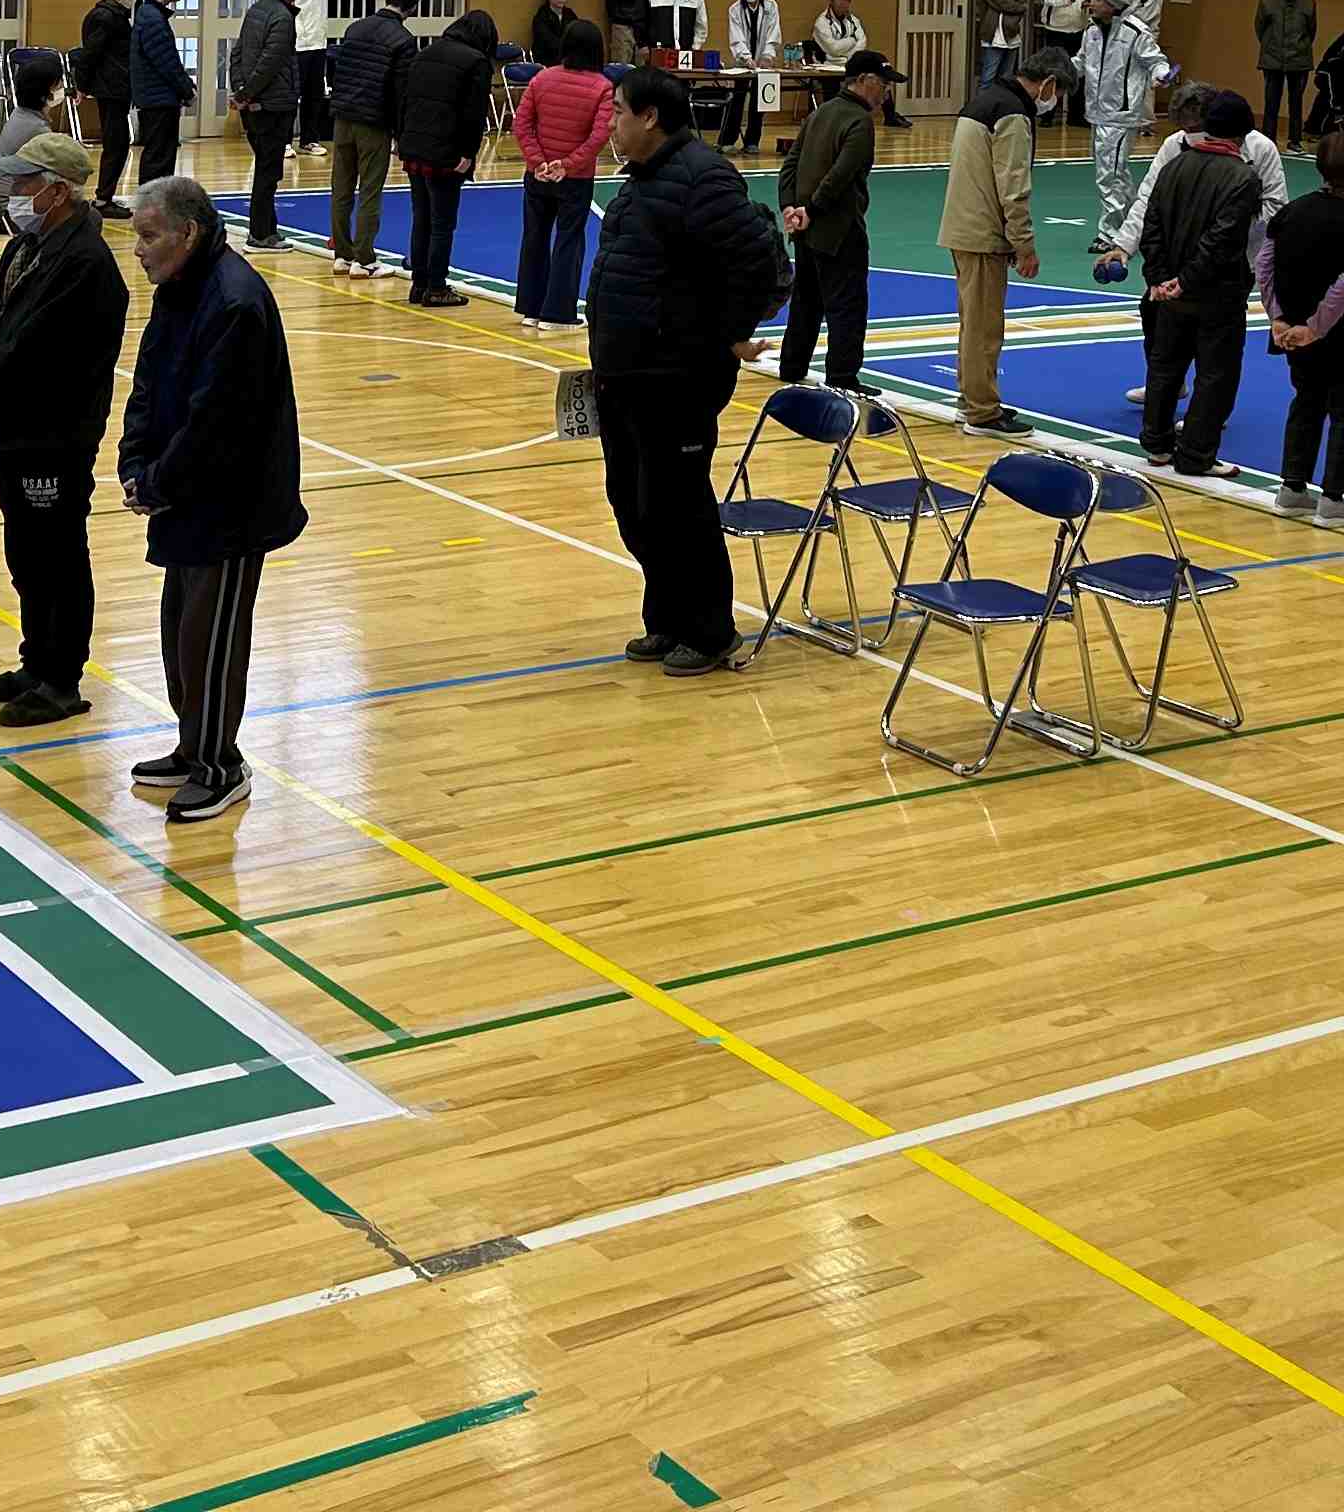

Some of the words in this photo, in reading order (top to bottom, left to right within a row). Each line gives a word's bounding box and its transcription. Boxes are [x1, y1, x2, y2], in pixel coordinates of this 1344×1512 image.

[679, 52, 691, 68] 4
[761, 82, 776, 104] C
[572, 373, 590, 436] BOCCIA
